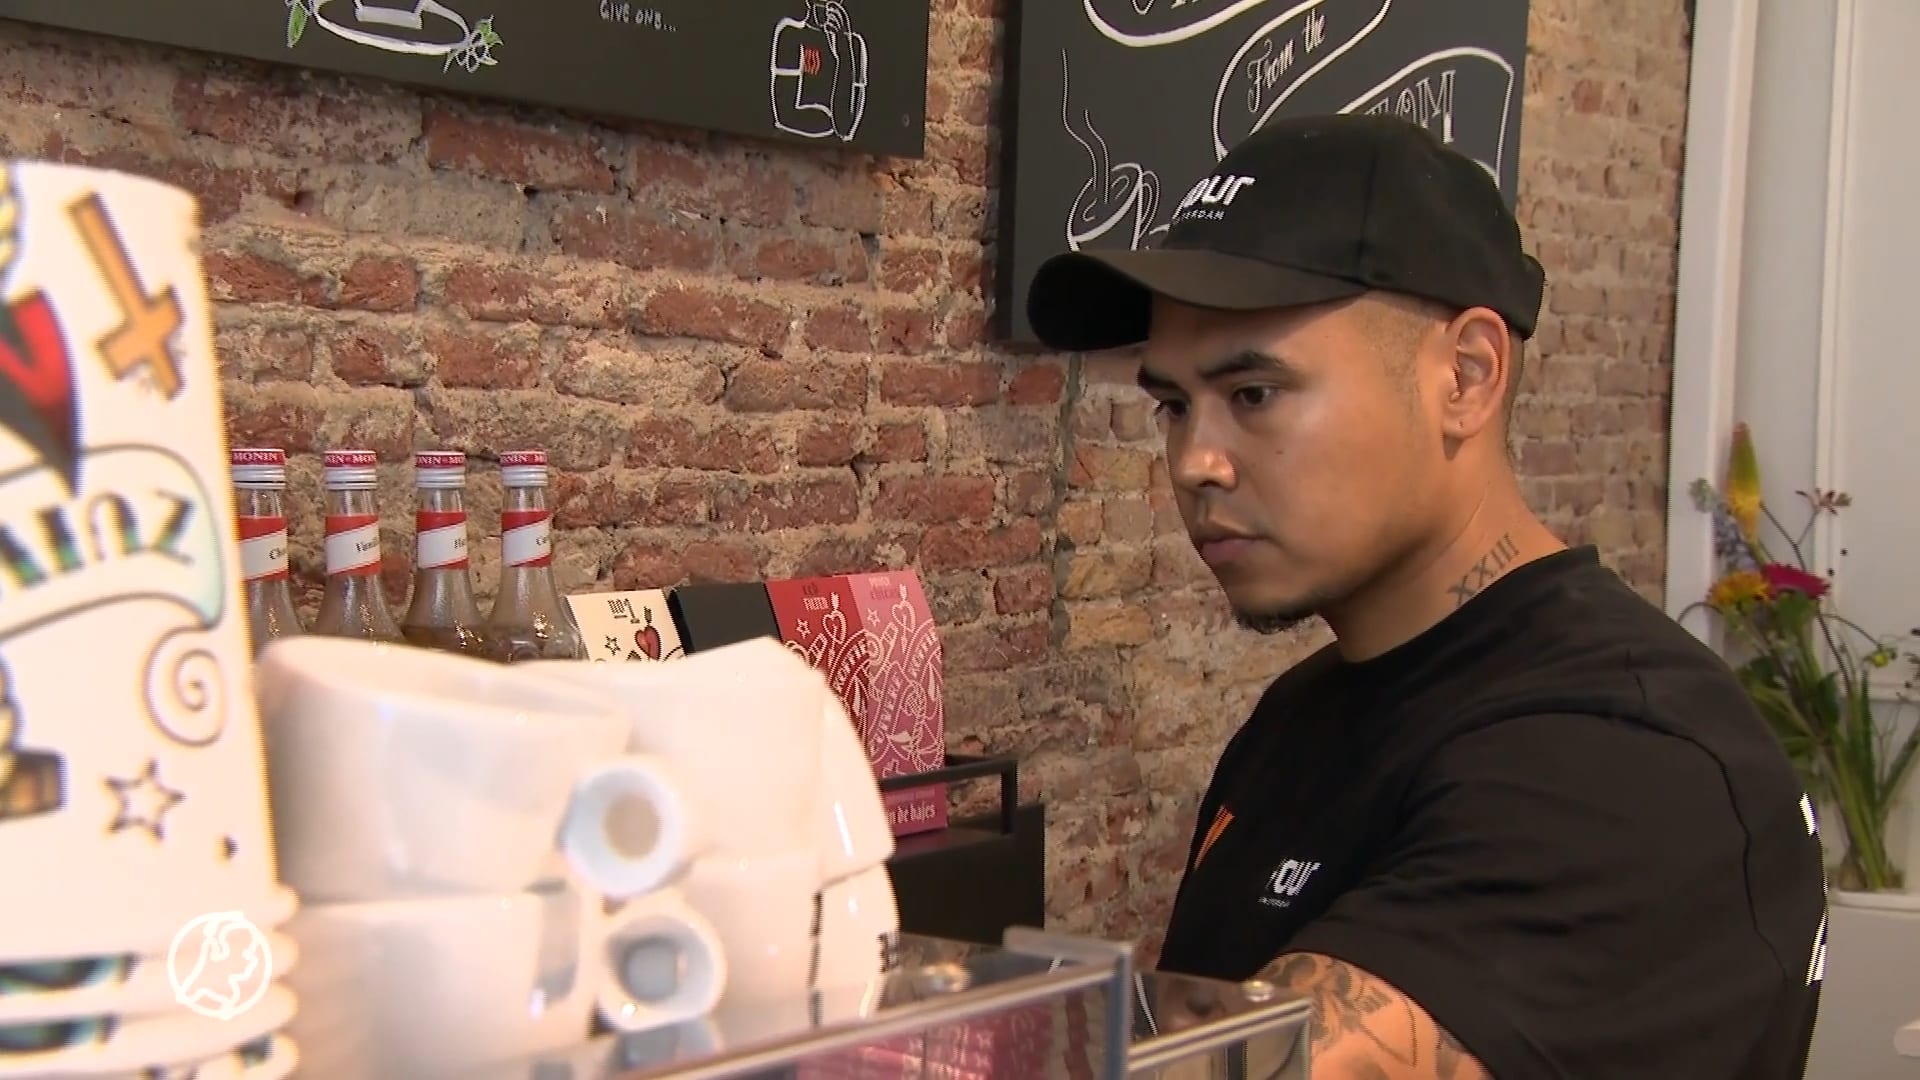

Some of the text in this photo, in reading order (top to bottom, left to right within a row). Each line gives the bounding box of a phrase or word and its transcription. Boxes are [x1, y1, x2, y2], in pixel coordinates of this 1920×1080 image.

[1247, 7, 1327, 113] From the
[232, 451, 280, 462] MONIN
